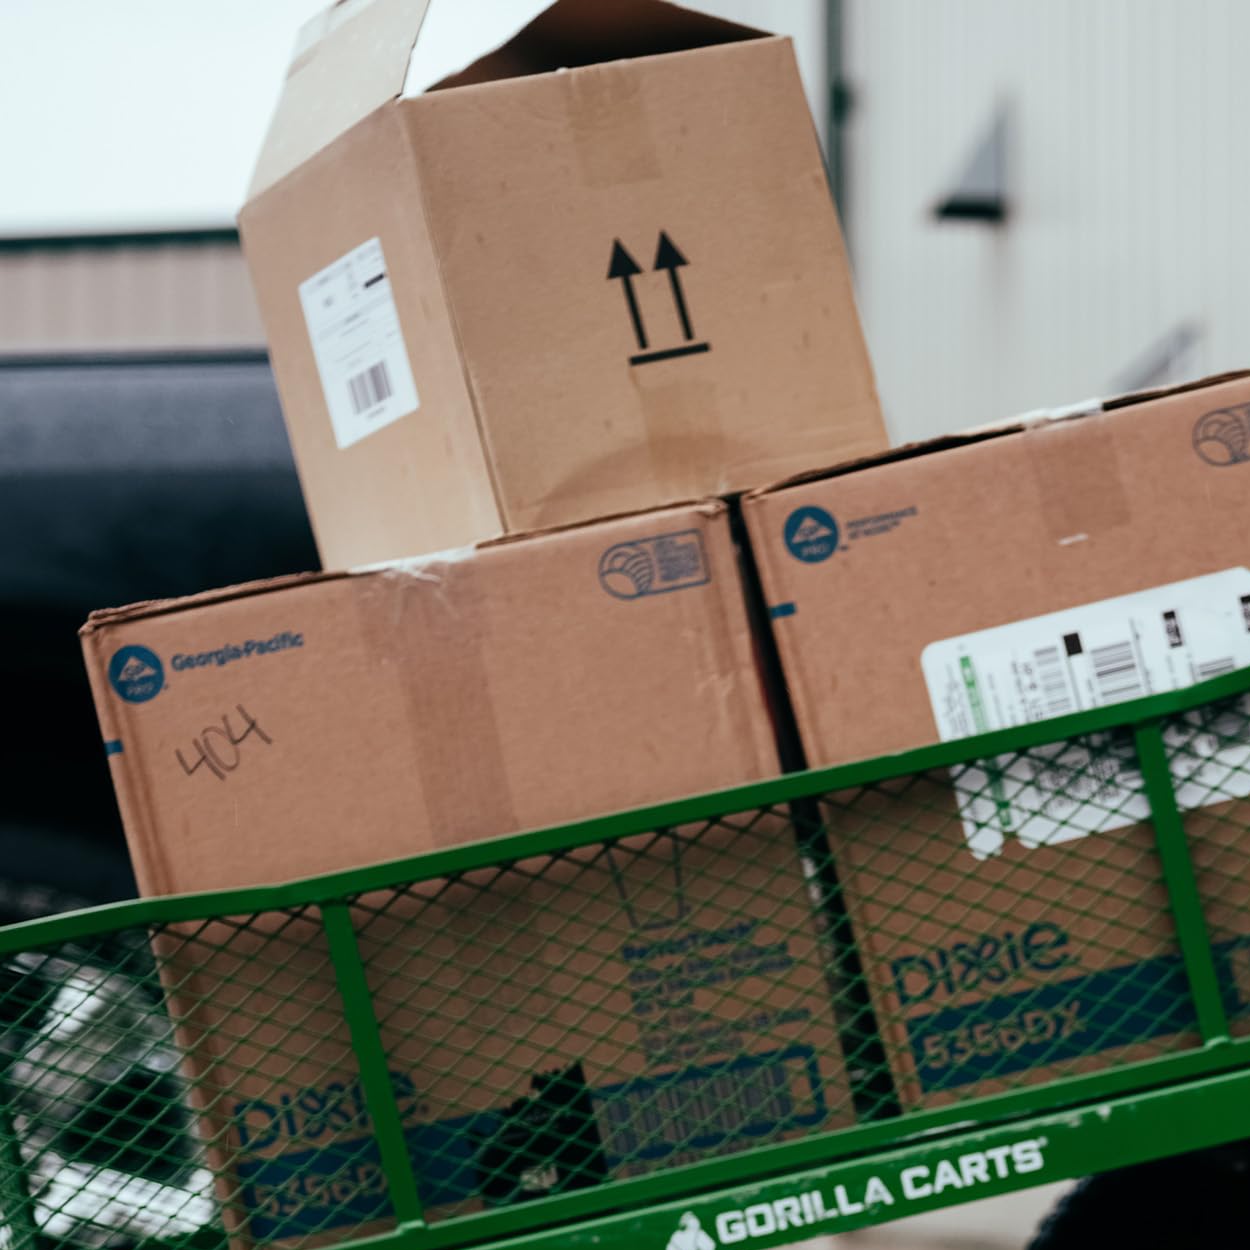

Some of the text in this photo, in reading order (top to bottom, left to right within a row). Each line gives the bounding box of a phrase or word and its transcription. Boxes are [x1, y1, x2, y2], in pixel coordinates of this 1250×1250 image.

[171, 632, 304, 672] Georgia-Pacific
[173, 703, 273, 782] 404
[890, 921, 1070, 1004] Dixie
[715, 1138, 1044, 1245] GORILLA CARTS
